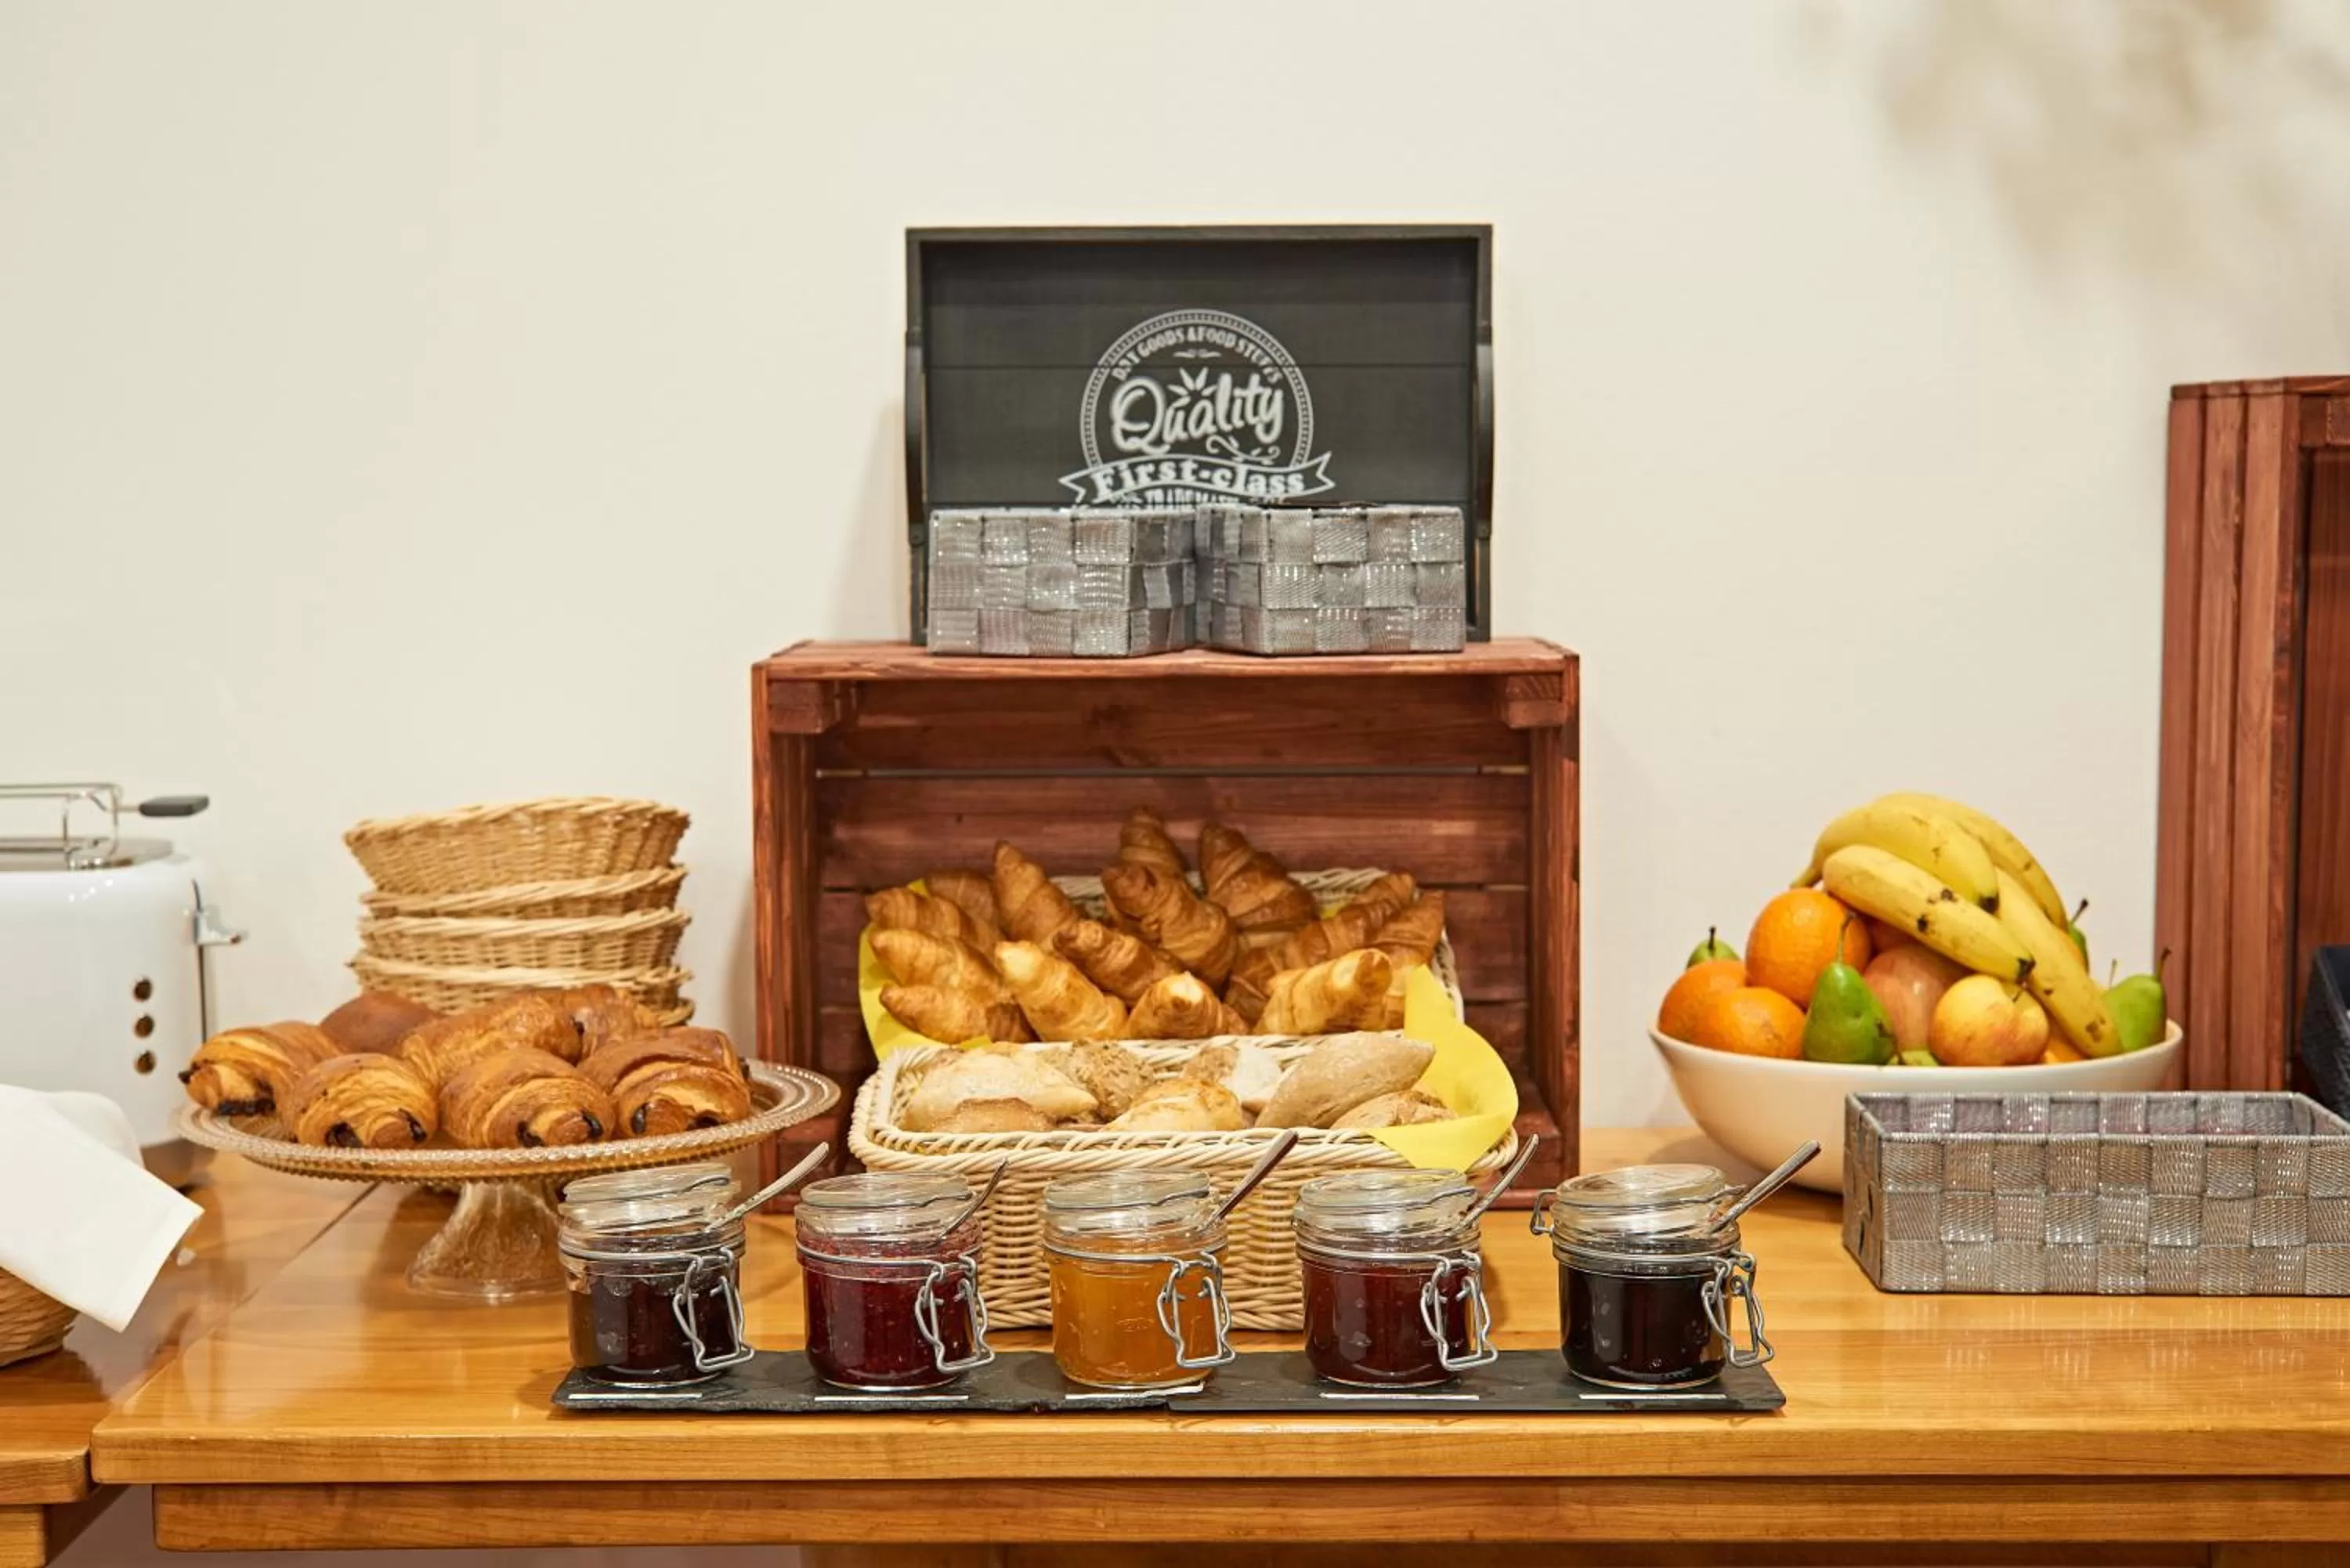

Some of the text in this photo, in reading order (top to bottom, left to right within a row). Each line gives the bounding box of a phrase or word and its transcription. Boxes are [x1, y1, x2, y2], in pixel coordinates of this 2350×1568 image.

[1137, 327, 1185, 358] GOODS
[1110, 372, 1285, 456] Quality
[1090, 458, 1305, 501] First-class
